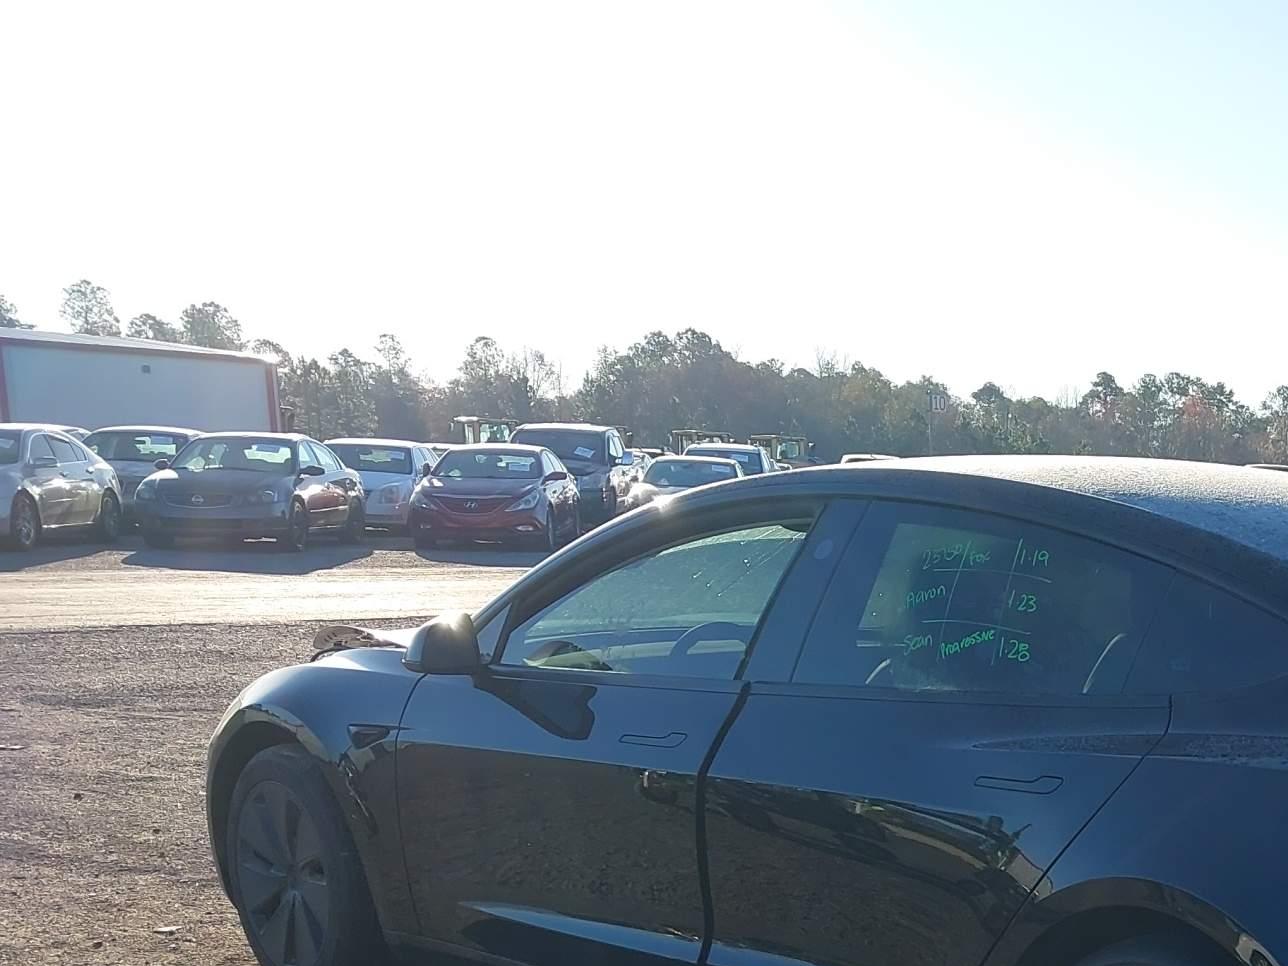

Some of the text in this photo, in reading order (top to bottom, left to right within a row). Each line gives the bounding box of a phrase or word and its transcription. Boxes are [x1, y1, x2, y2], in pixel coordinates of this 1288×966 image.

[905, 584, 1037, 612] Aaron 1.23
[903, 634, 933, 656] Sean
[998, 636, 1031, 662] 1.28
